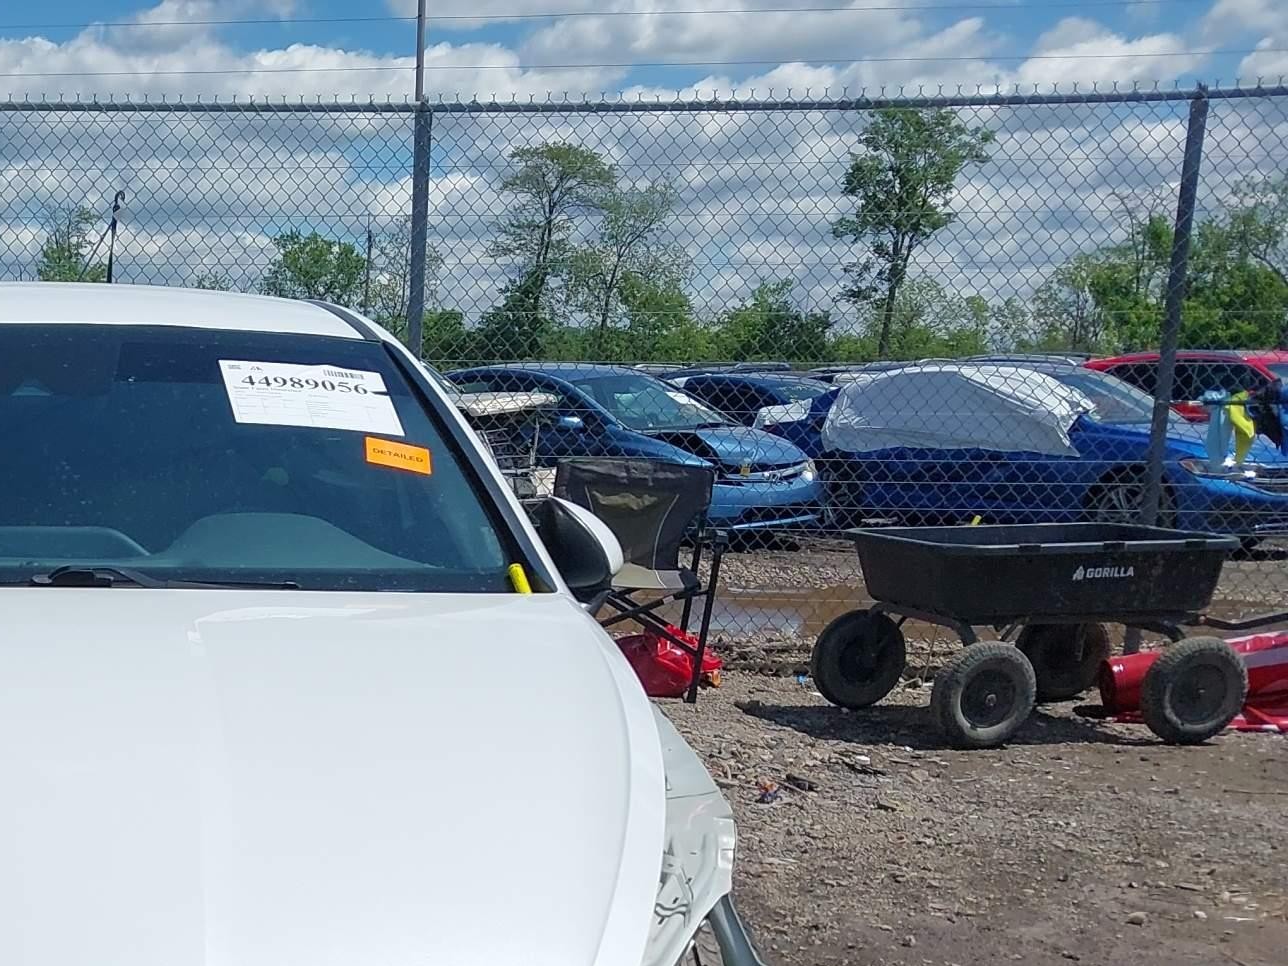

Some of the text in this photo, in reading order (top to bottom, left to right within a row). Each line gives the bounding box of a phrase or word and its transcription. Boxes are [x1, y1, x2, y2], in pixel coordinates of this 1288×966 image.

[241, 374, 368, 395] 44989056
[373, 447, 424, 463] DETAILED
[1086, 566, 1134, 578] GORILLA
